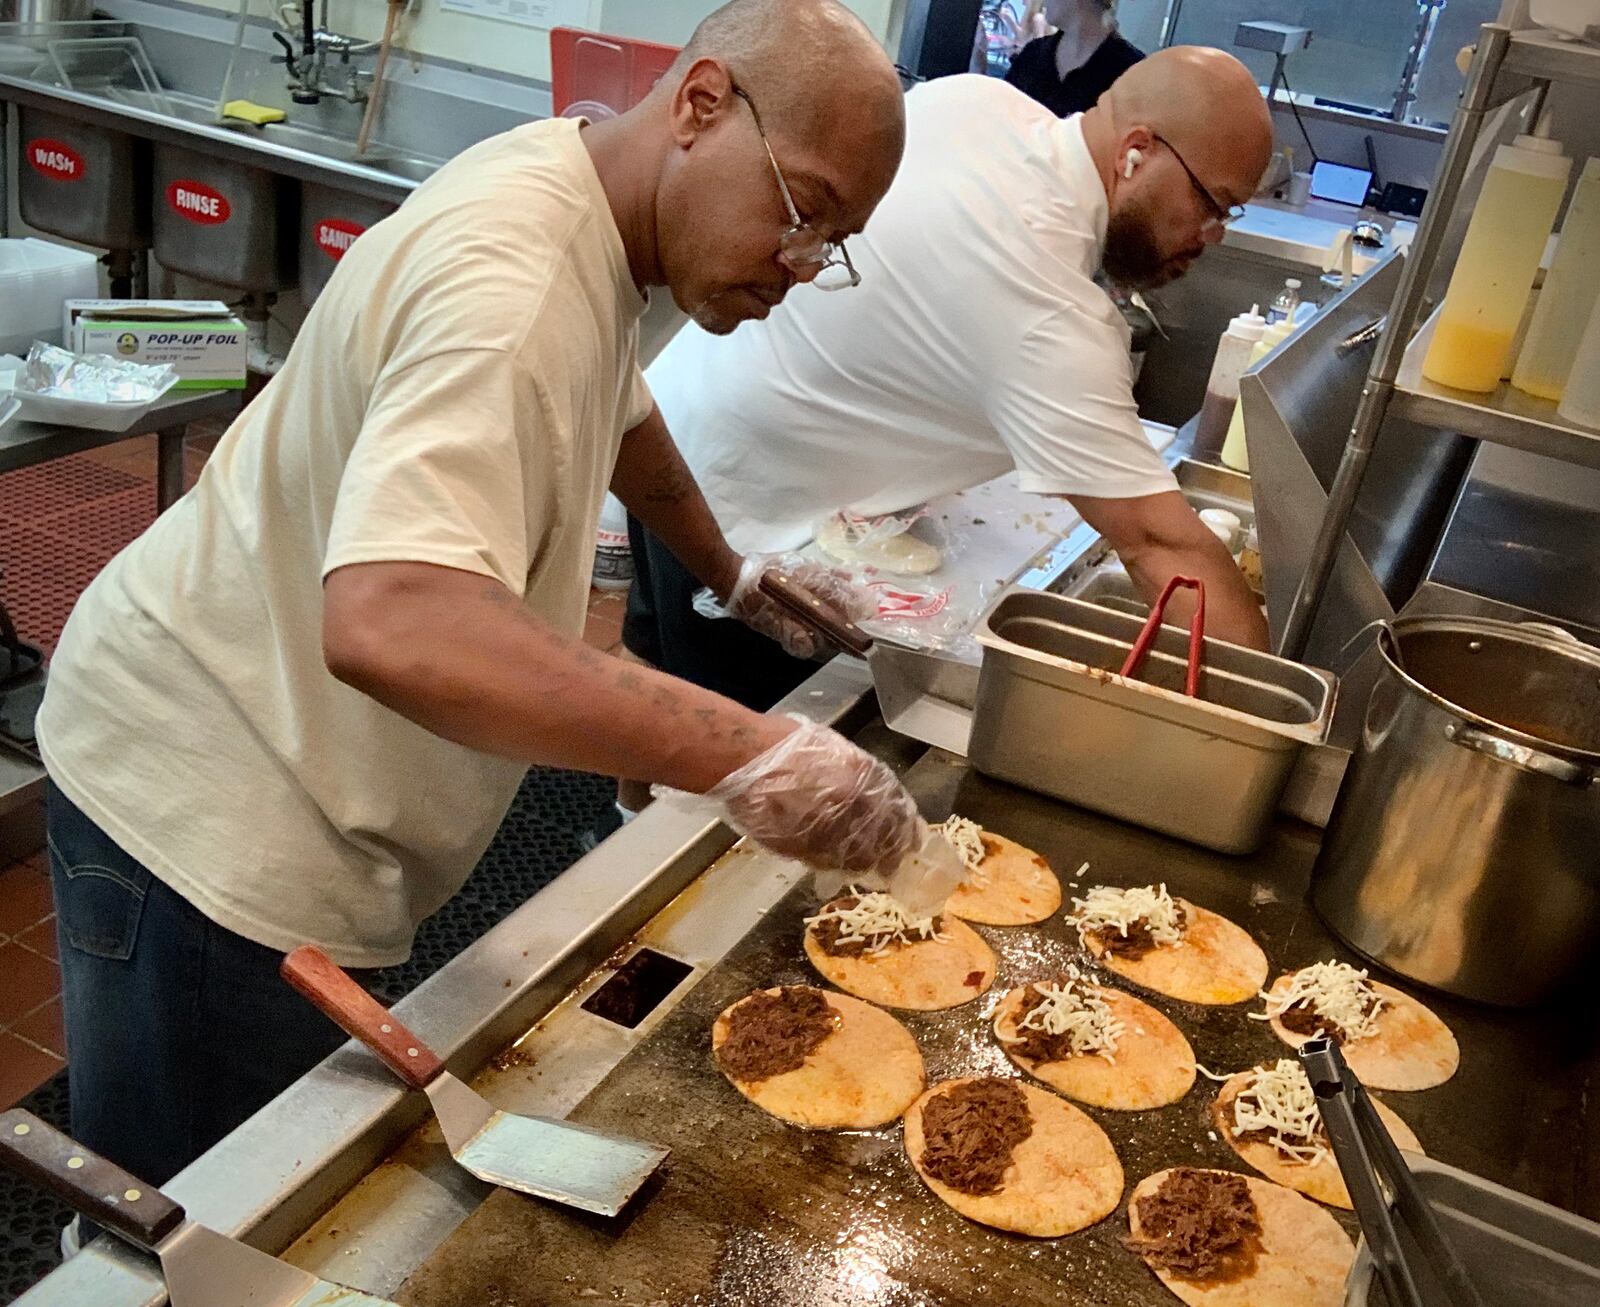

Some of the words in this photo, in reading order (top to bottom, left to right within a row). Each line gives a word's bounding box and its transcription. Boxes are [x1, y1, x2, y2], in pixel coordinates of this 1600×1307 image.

[35, 148, 75, 174] WASH
[176, 188, 220, 217] RINSE
[146, 333, 204, 345] POP-UP
[205, 334, 239, 345] FOIL
